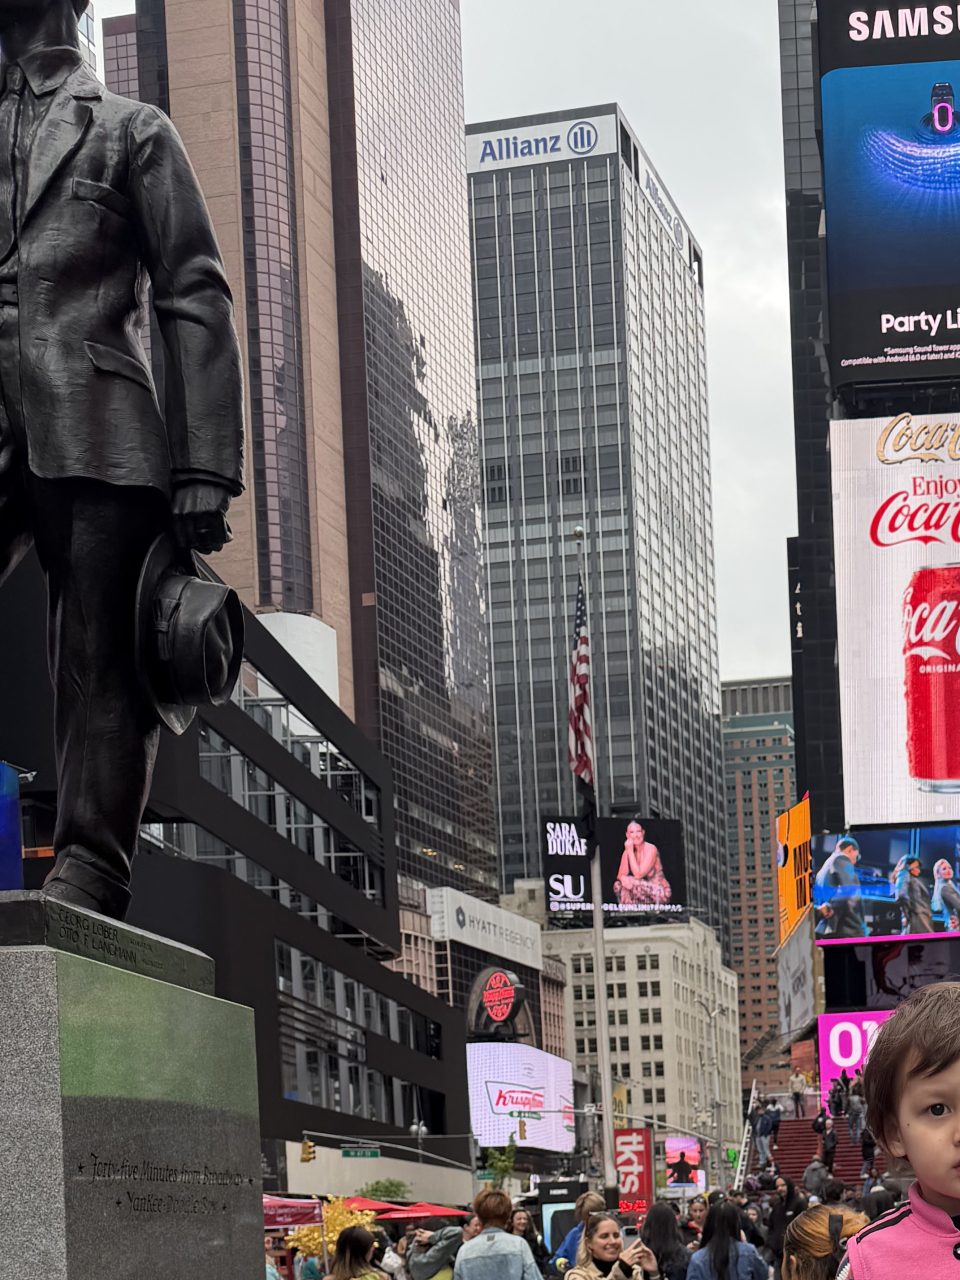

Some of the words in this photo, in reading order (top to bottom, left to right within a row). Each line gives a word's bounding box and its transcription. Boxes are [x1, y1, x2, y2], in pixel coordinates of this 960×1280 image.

[479, 133, 562, 164] Allianz
[880, 313, 943, 337] Party
[546, 822, 579, 842] SARA
[548, 874, 585, 899] SU
[92, 920, 119, 944] LOBER
[468, 914, 498, 937] HYATT
[498, 927, 536, 950] REGENCY
[139, 1160, 178, 1184] Minutes
[615, 1132, 645, 1195] tkts
